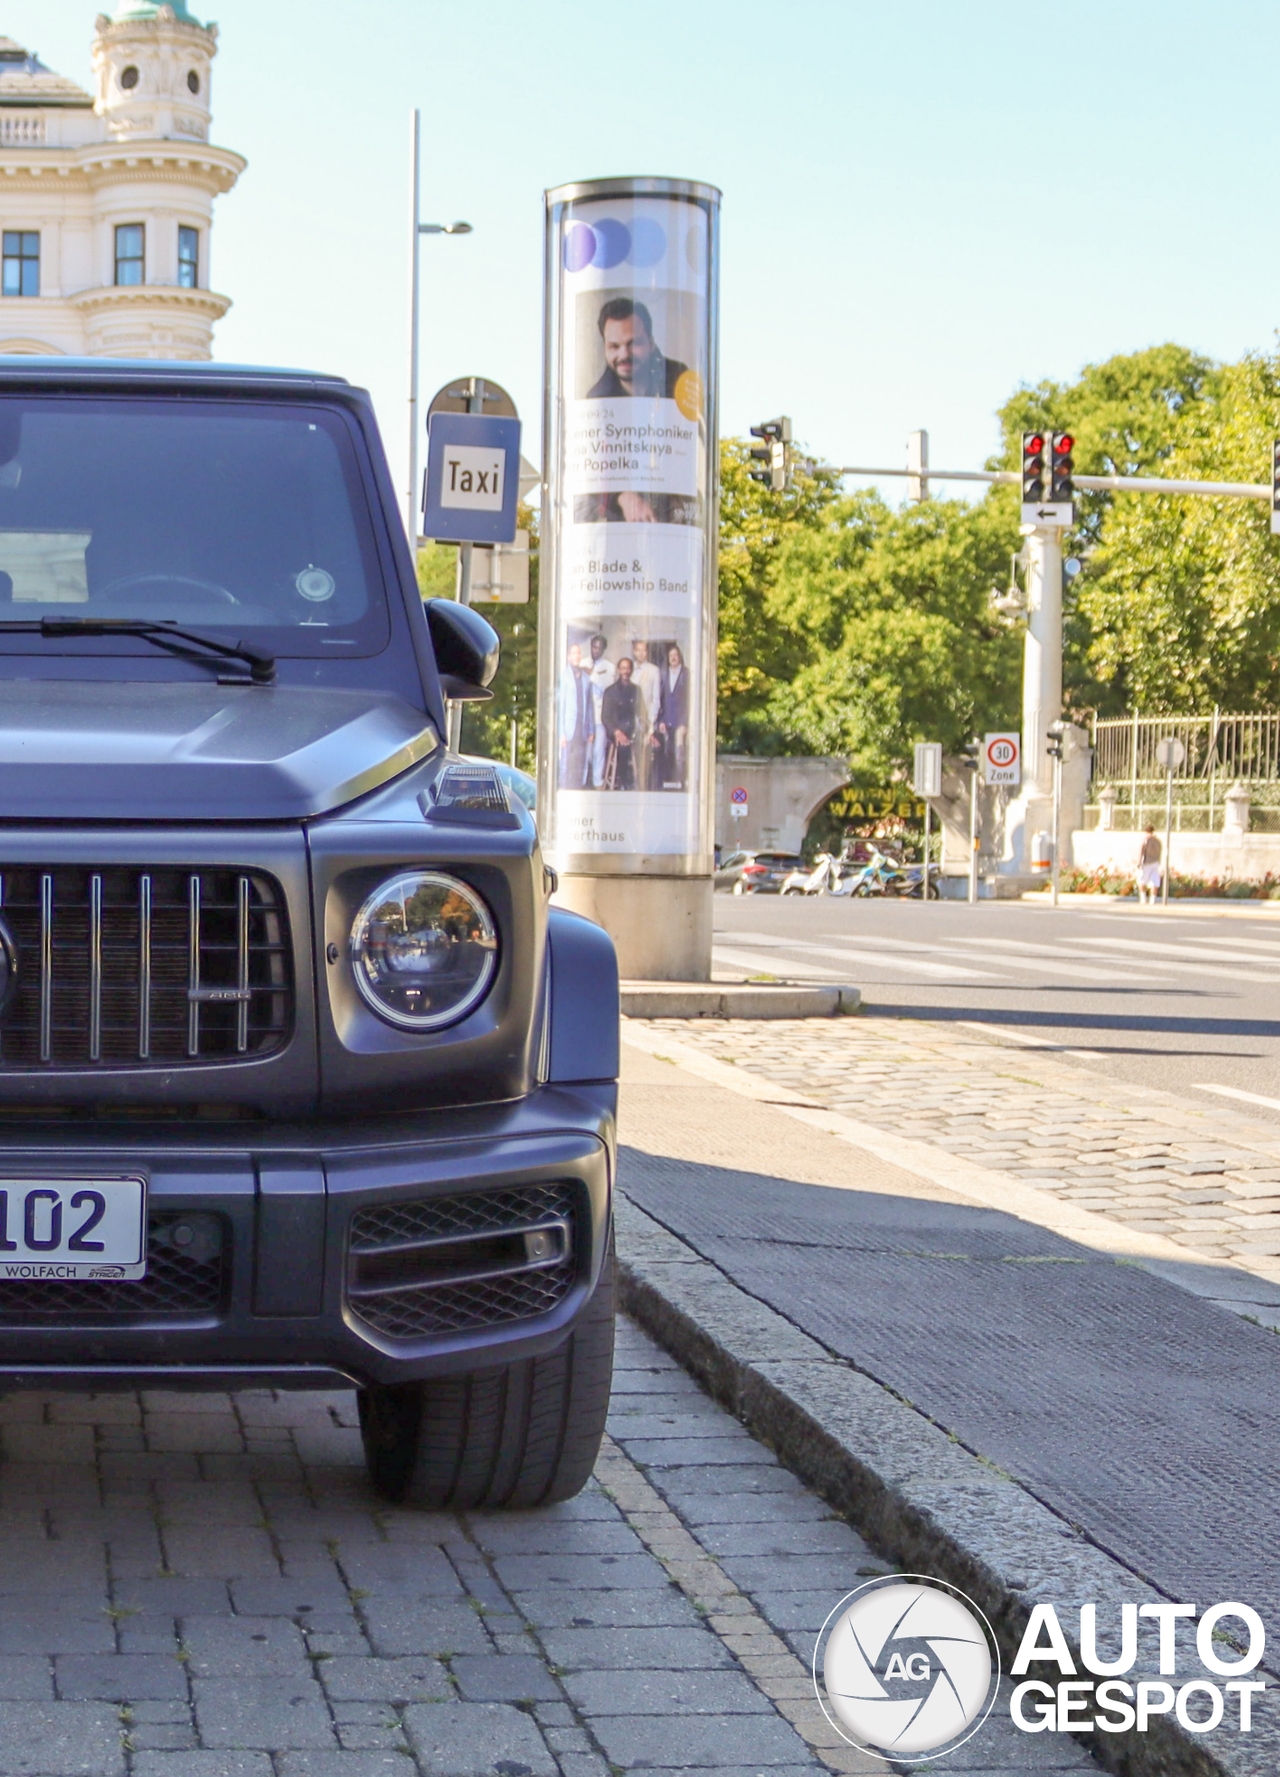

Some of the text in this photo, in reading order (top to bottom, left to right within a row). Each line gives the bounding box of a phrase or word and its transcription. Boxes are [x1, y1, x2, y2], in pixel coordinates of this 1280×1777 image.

[574, 423, 693, 441] ener Symphoniker
[591, 440, 673, 456] Vinnitskaya
[584, 457, 640, 473] Popelka
[448, 460, 499, 495] Taxi
[588, 560, 628, 574] Blade
[632, 559, 644, 573] &
[580, 578, 655, 593] Fellowship
[659, 578, 689, 593] Band
[996, 746, 1010, 760] 30
[990, 769, 1015, 781] Zone
[830, 802, 926, 818] WALZER
[574, 830, 625, 842] erthaus
[5, 1266, 77, 1278] WOLFACH
